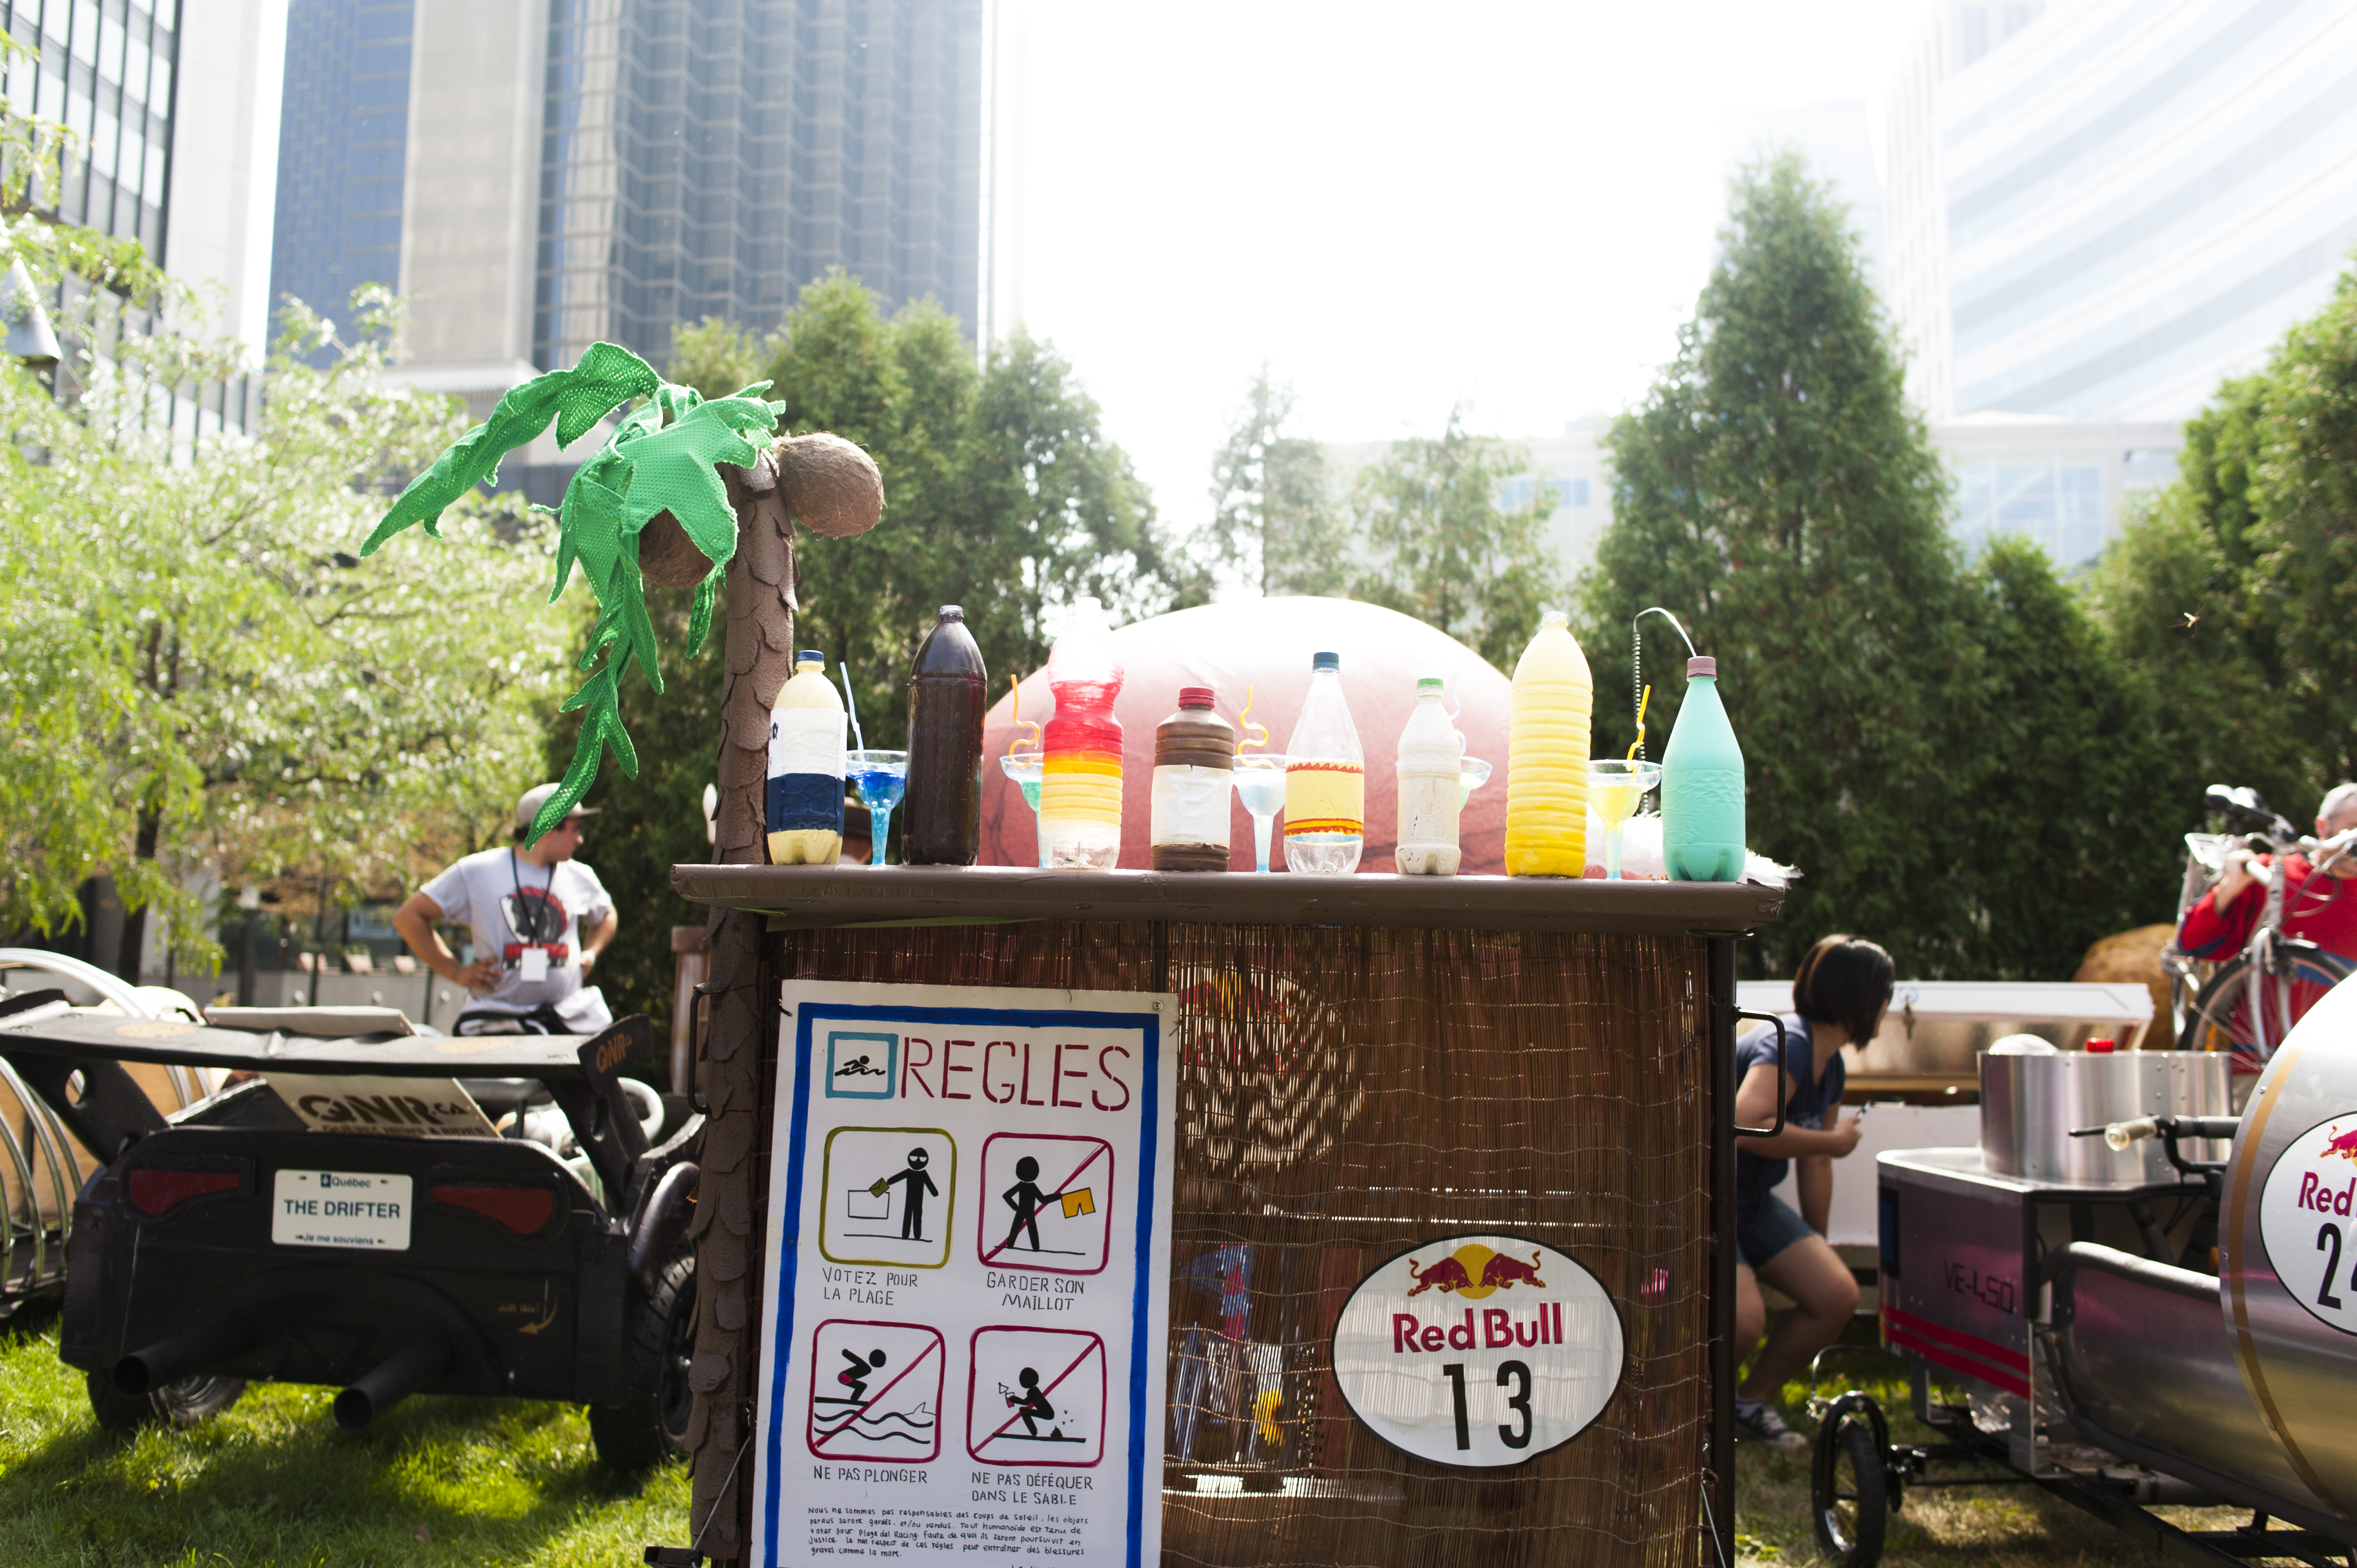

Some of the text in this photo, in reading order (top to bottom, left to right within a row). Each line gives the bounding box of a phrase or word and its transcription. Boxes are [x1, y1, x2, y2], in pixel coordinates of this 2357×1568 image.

[901, 1036, 1130, 1112] REGLES
[332, 1177, 372, 1188] Québec
[2298, 1171, 2356, 1216] Red
[284, 1199, 400, 1218] THE DRIFTER
[333, 1235, 374, 1245] souviens
[2317, 1223, 2357, 1311] 2
[822, 1266, 918, 1287] VOTEZ POUR
[987, 1271, 1084, 1294] GARDER SON
[824, 1287, 894, 1306] LA PLAGE
[1002, 1293, 1074, 1311] MAILLOT
[1393, 1302, 1563, 1353] Red Bull
[1443, 1360, 1532, 1450] 13
[814, 1465, 927, 1483] NE PAS PLONGER
[971, 1472, 1093, 1490] NE PAS DÉFÉQUER
[972, 1490, 1077, 1505] DANS LE SABLE
[899, 1509, 952, 1518] responsables
[974, 1513, 994, 1521] coups
[1048, 1514, 1059, 1522] les
[1063, 1515, 1088, 1525] objets
[900, 1519, 920, 1528] et/ou
[982, 1522, 1025, 1531] humanoïde
[932, 1541, 953, 1550] règles
[963, 1544, 980, 1552] peut
[983, 1544, 1021, 1552] entraîner
[1044, 1546, 1084, 1555] blessures
[1021, 1536, 1063, 1544] poursuivit
[811, 1547, 835, 1555] graves
